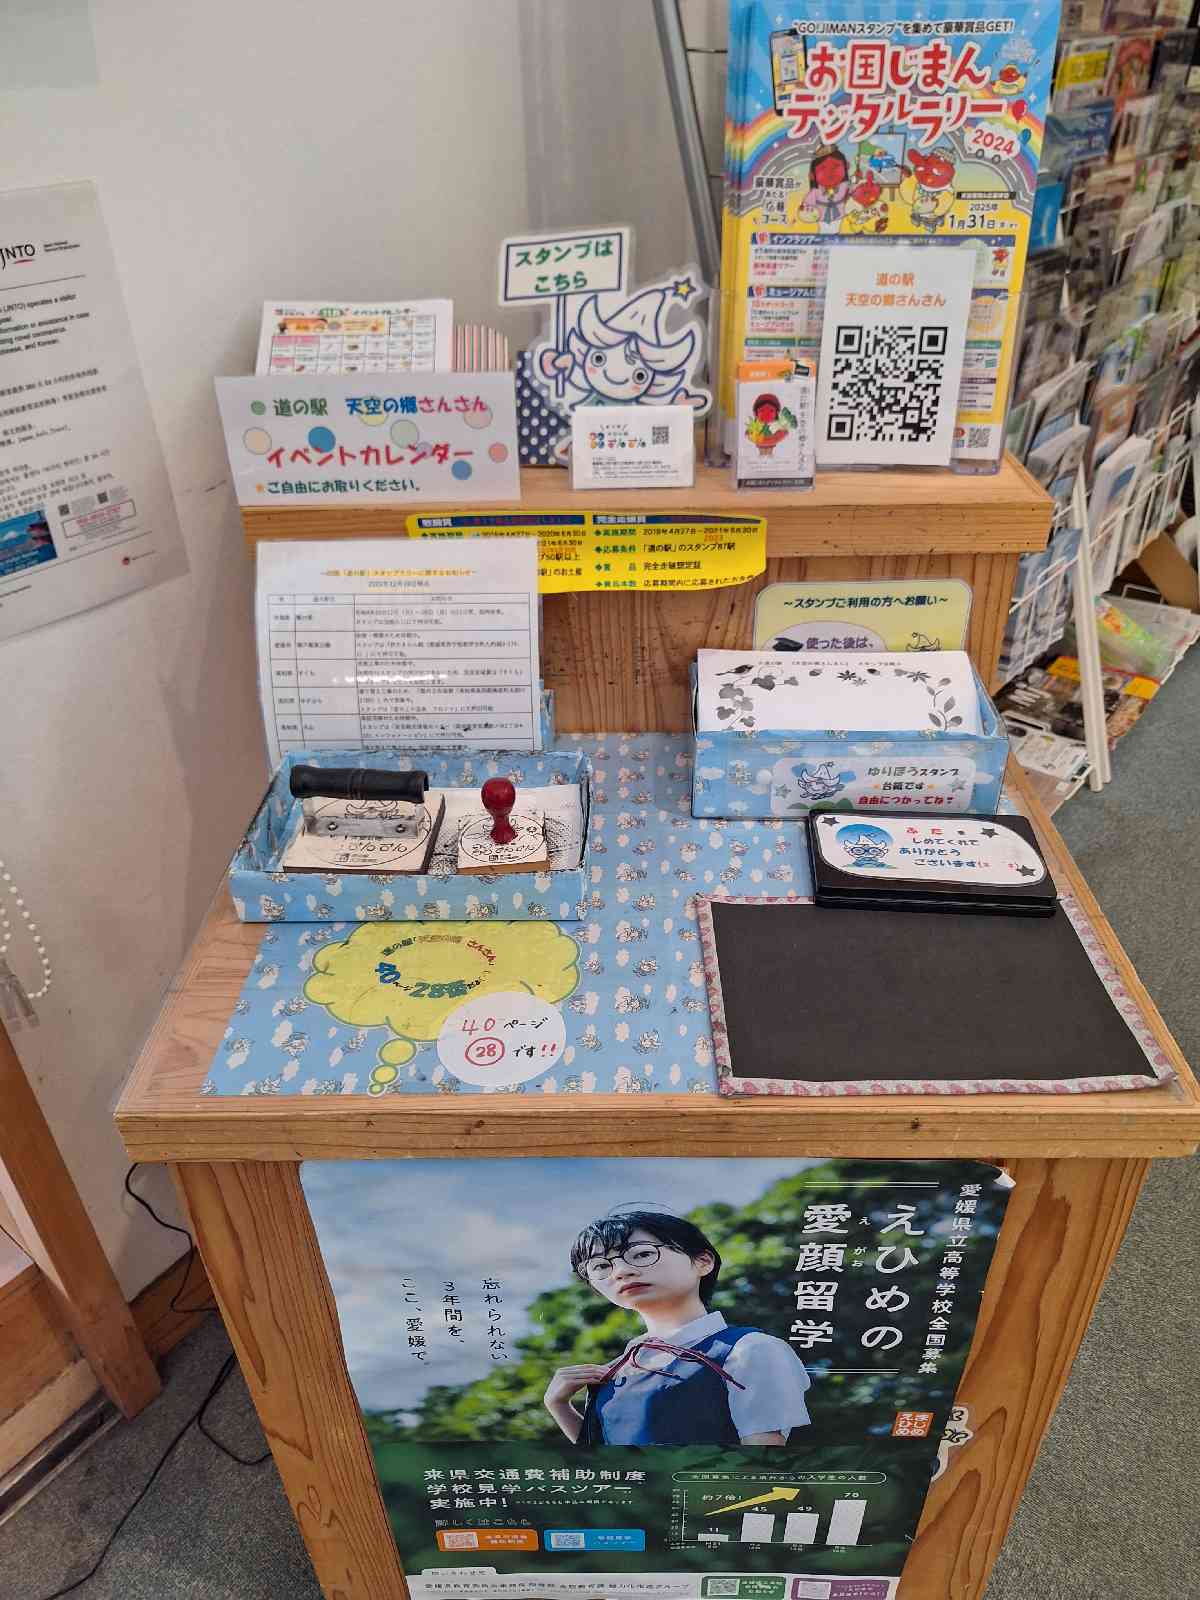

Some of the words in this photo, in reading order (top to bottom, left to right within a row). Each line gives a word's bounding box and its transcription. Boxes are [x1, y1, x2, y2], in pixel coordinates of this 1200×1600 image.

[806, 43, 990, 90] お国じまん
[786, 94, 1006, 144] デジタルラリー
[972, 129, 1014, 155] 2024
[949, 214, 995, 228] 1月31日
[0, 243, 36, 270] JNTO
[515, 240, 613, 268] スタンプは
[534, 271, 588, 293] こちら
[876, 273, 915, 286] 道の駅
[846, 292, 946, 307] 天空の郷さんさん
[273, 399, 328, 417] 道の駅
[345, 396, 488, 415] 天空の郷さんさん
[267, 443, 473, 468] イベントカレンダー
[267, 480, 421, 495] ご自由にお取りください。
[806, 637, 874, 650] 使った後は、
[882, 781, 924, 791] 台紙です
[899, 847, 960, 856] ありがとう
[912, 838, 980, 846] しめてくれて
[462, 1017, 496, 1035] 40
[503, 1016, 549, 1029] ページ
[859, 1216, 871, 1225] え
[789, 1203, 851, 1349] 愛顔留学
[861, 1204, 925, 1350] えひめの
[918, 1184, 983, 1374] 愛媛県立高等学校全国募集
[402, 1278, 430, 1365] ここ、愛媛で。
[482, 1277, 509, 1360] 忘れられない
[424, 1468, 647, 1482] 来県交通費補助制度
[426, 1483, 633, 1495] 学校見学バスツアー
[430, 1497, 508, 1510] 実施中!
